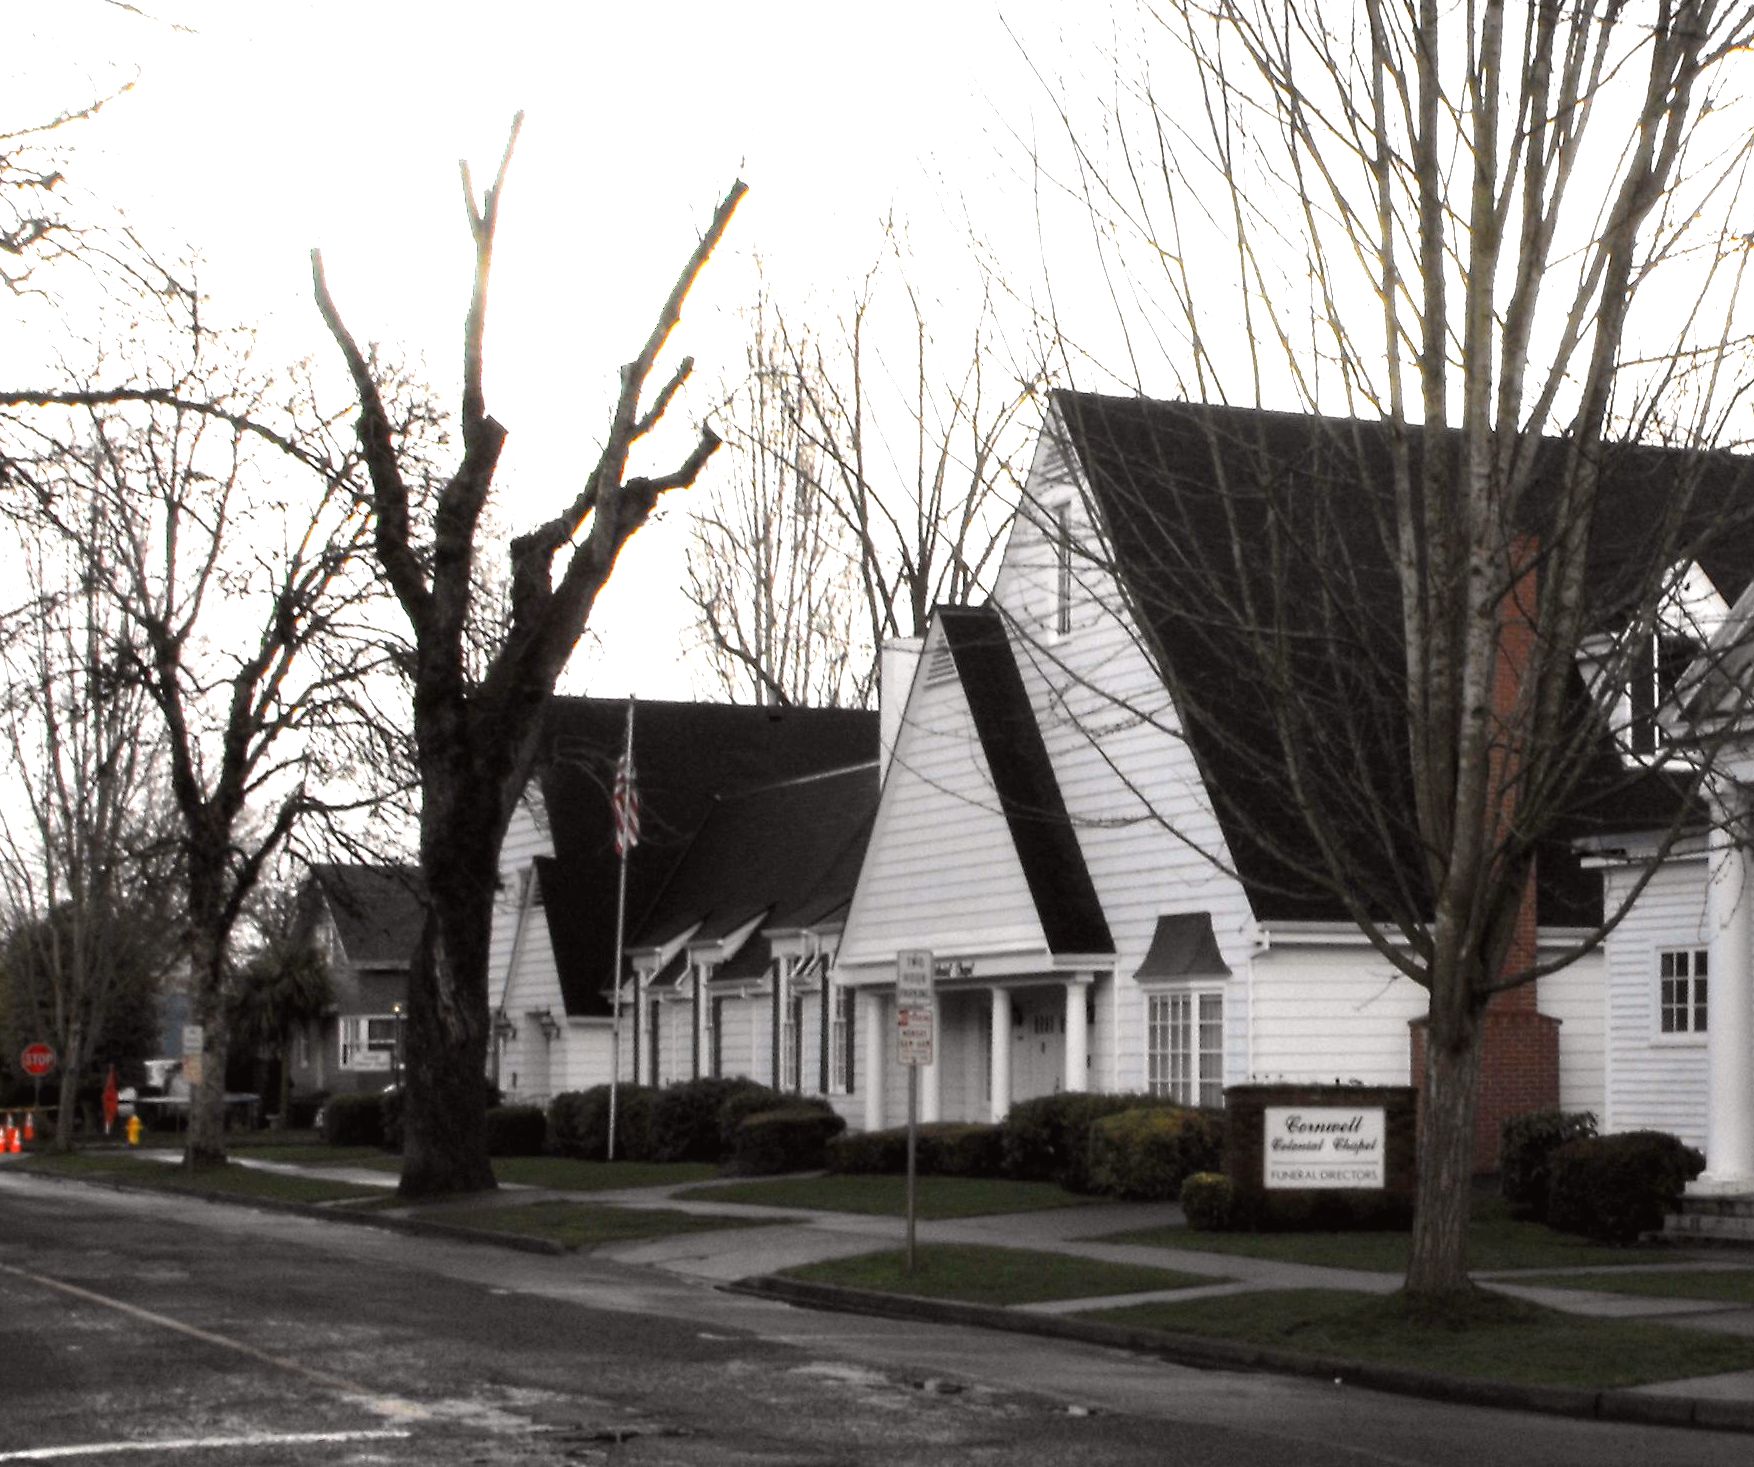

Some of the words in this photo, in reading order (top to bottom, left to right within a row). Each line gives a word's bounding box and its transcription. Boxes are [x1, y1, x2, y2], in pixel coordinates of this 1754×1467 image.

[25, 1053, 53, 1066] STOP
[1285, 1115, 1363, 1134] Cornwell
[1271, 1136, 1325, 1151] Colonial
[1332, 1136, 1377, 1155] Chapel
[1271, 1169, 1316, 1180] FUNERAL
[1320, 1169, 1378, 1181] DIRECTORS
